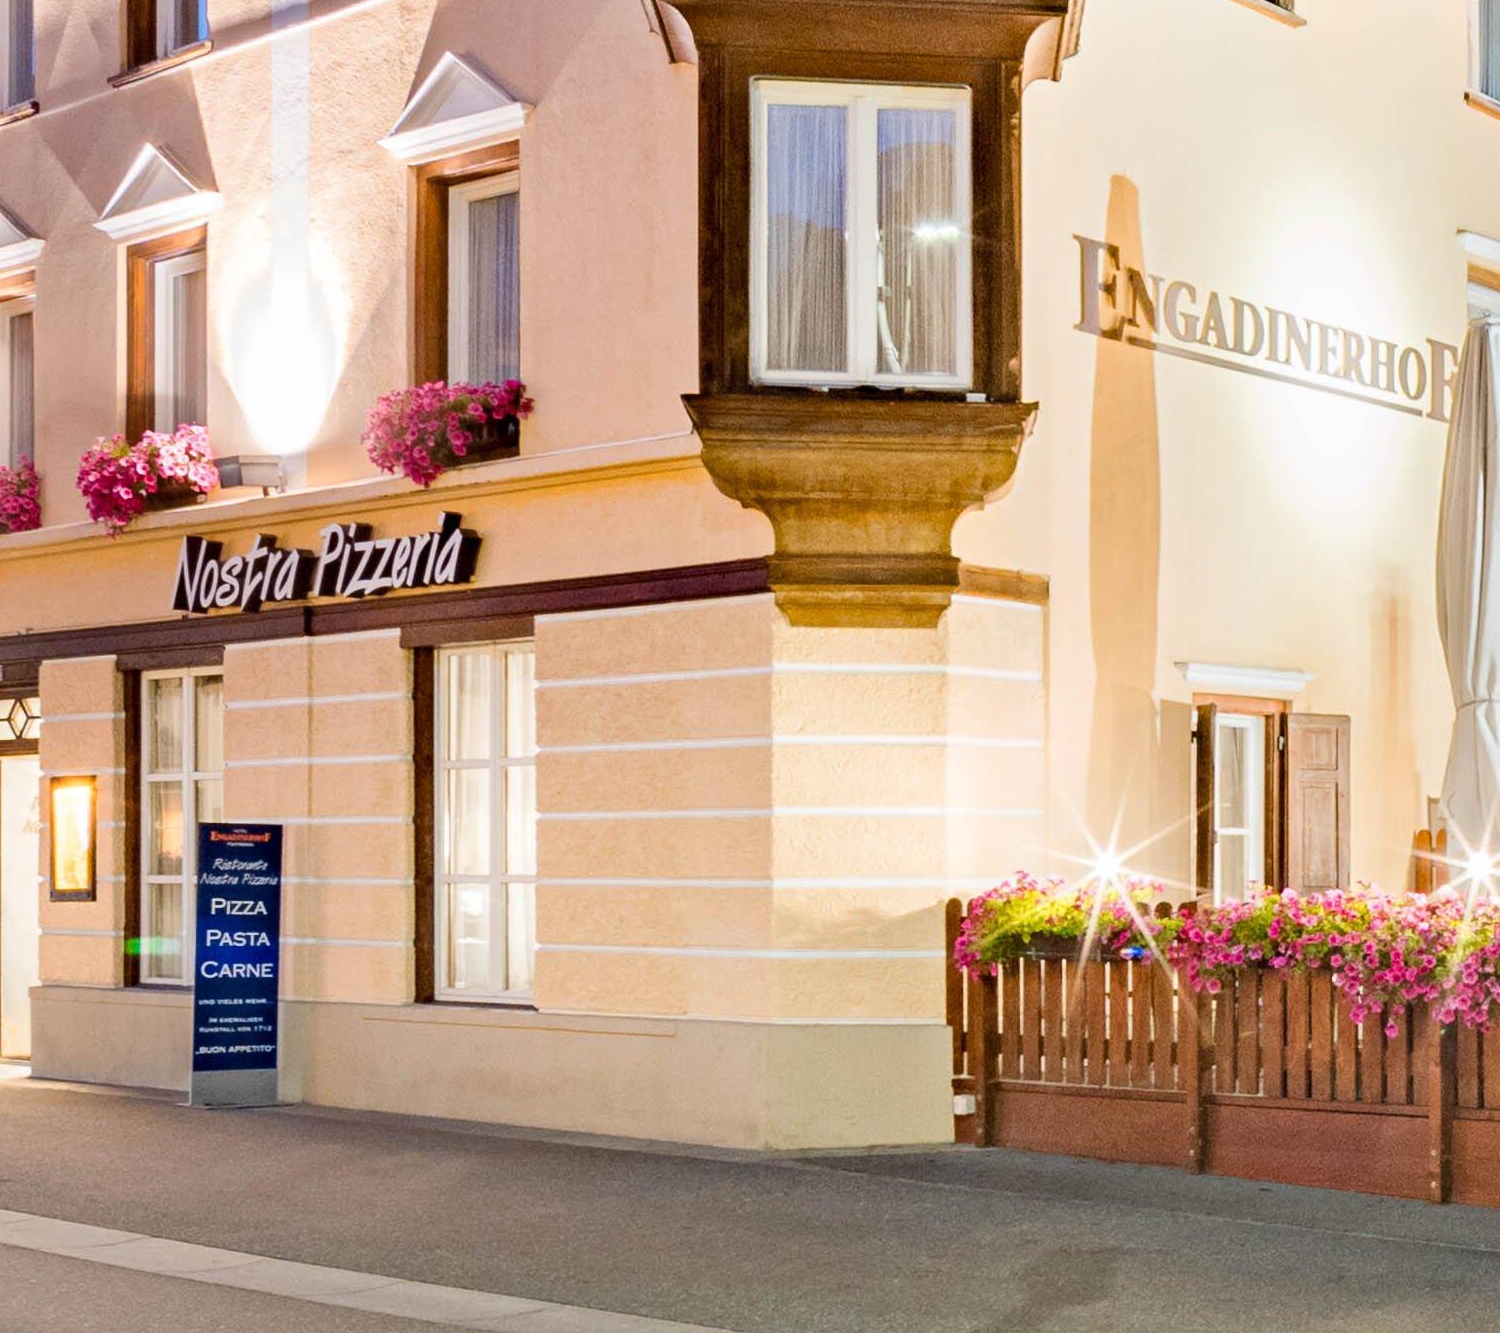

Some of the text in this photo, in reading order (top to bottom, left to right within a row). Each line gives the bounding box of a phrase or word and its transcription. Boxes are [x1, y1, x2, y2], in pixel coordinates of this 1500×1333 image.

[1072, 233, 1460, 423] ENGADINERHOF
[172, 510, 464, 611] Nostra Pizzeria
[211, 897, 268, 915] PIZZA
[206, 929, 271, 947] PASTA
[201, 960, 274, 978] CARNE
